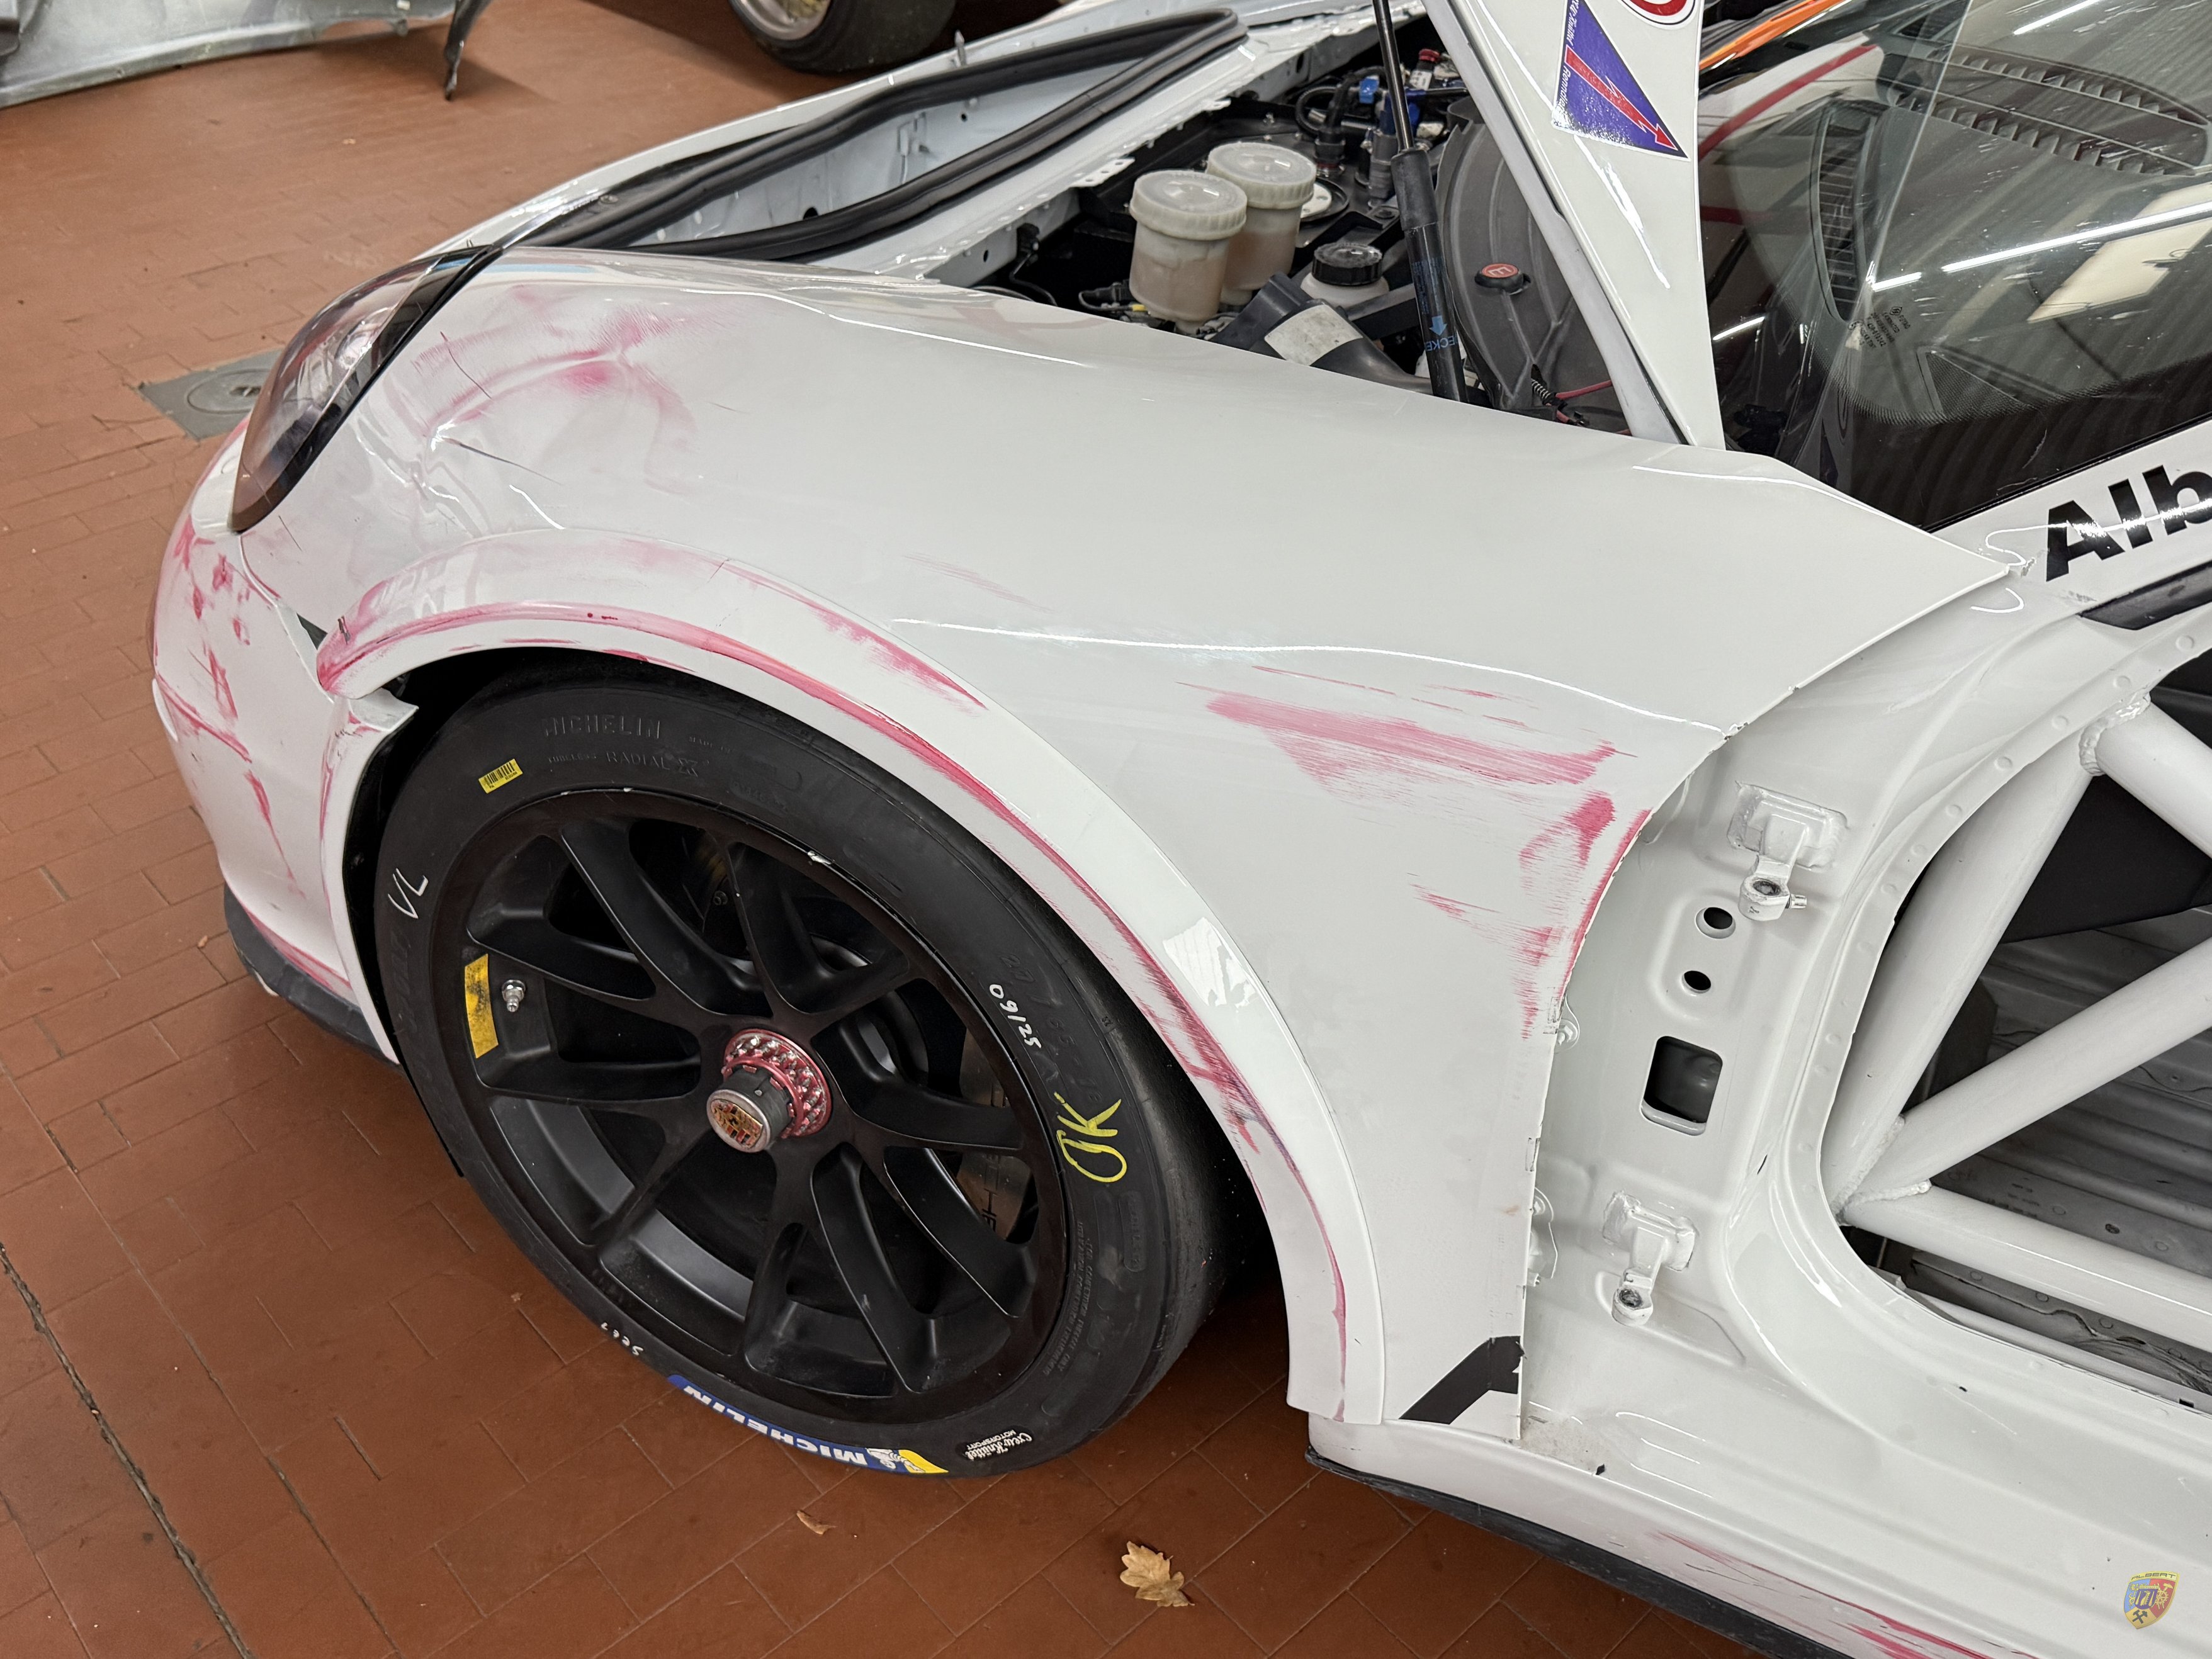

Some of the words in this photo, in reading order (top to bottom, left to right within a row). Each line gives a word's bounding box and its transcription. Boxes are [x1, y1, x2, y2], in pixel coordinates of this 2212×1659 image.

[1488, 266, 1512, 276] E
[1424, 335, 1457, 351] ECKE
[2046, 464, 2212, 582] Alb
[541, 714, 660, 739] MICHELIN
[606, 751, 670, 770] RADIAL
[989, 984, 1042, 1049] 09/25
[1054, 1091, 1127, 1183] OK
[683, 1385, 869, 1466] MICHELIN
[966, 1429, 1017, 1450] MOTORSPORT
